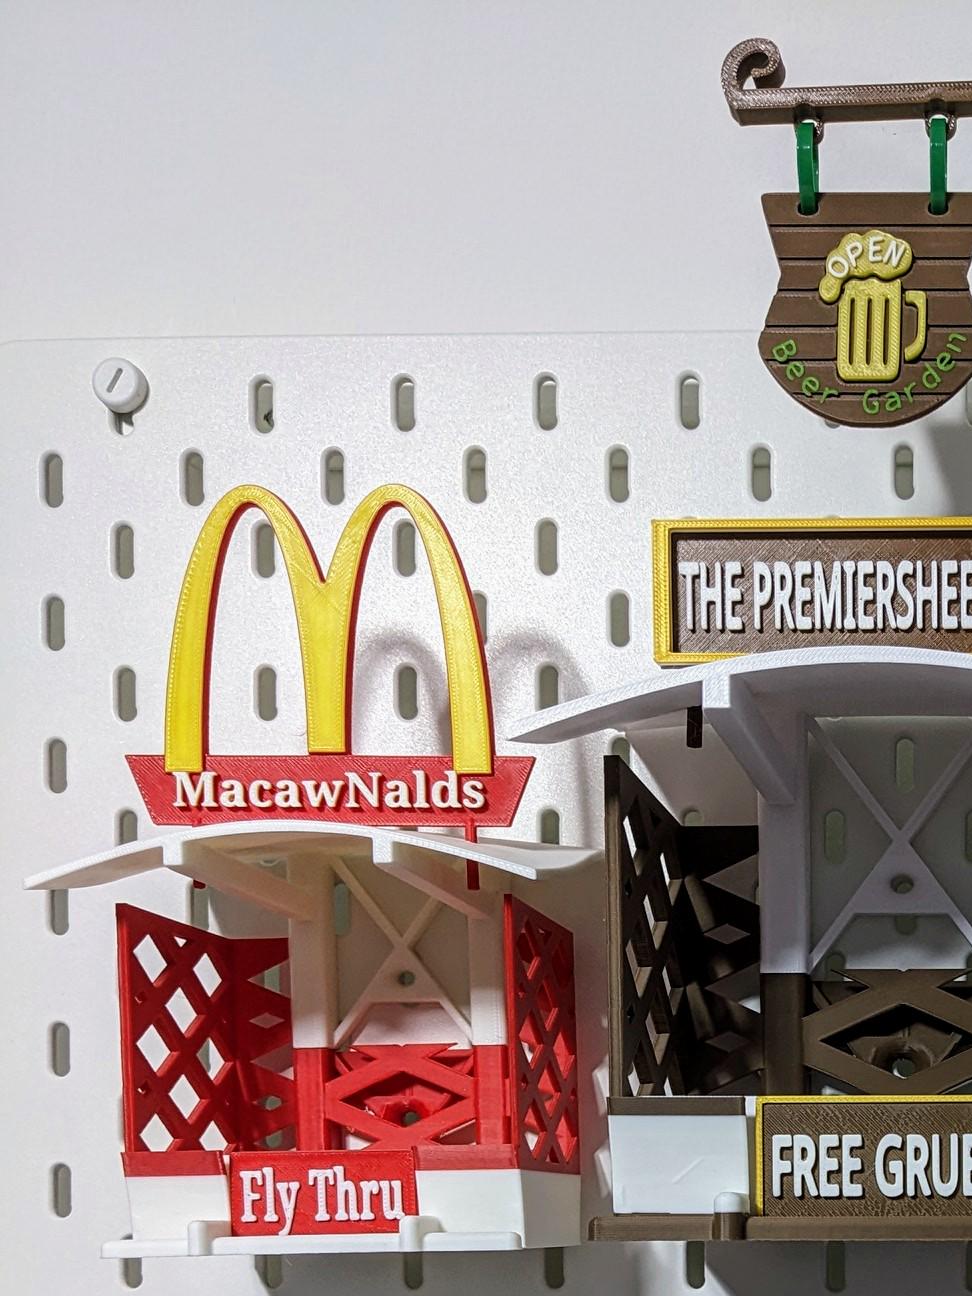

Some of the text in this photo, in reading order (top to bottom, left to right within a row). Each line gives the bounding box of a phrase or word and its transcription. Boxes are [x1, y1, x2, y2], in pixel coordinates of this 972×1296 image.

[827, 236, 906, 278] OPEN
[772, 332, 968, 415] Beer Garden
[678, 560, 744, 632] THE
[172, 769, 486, 810] MacawNalds
[771, 1133, 864, 1198] FREE
[239, 1165, 405, 1236] Fly Thru
